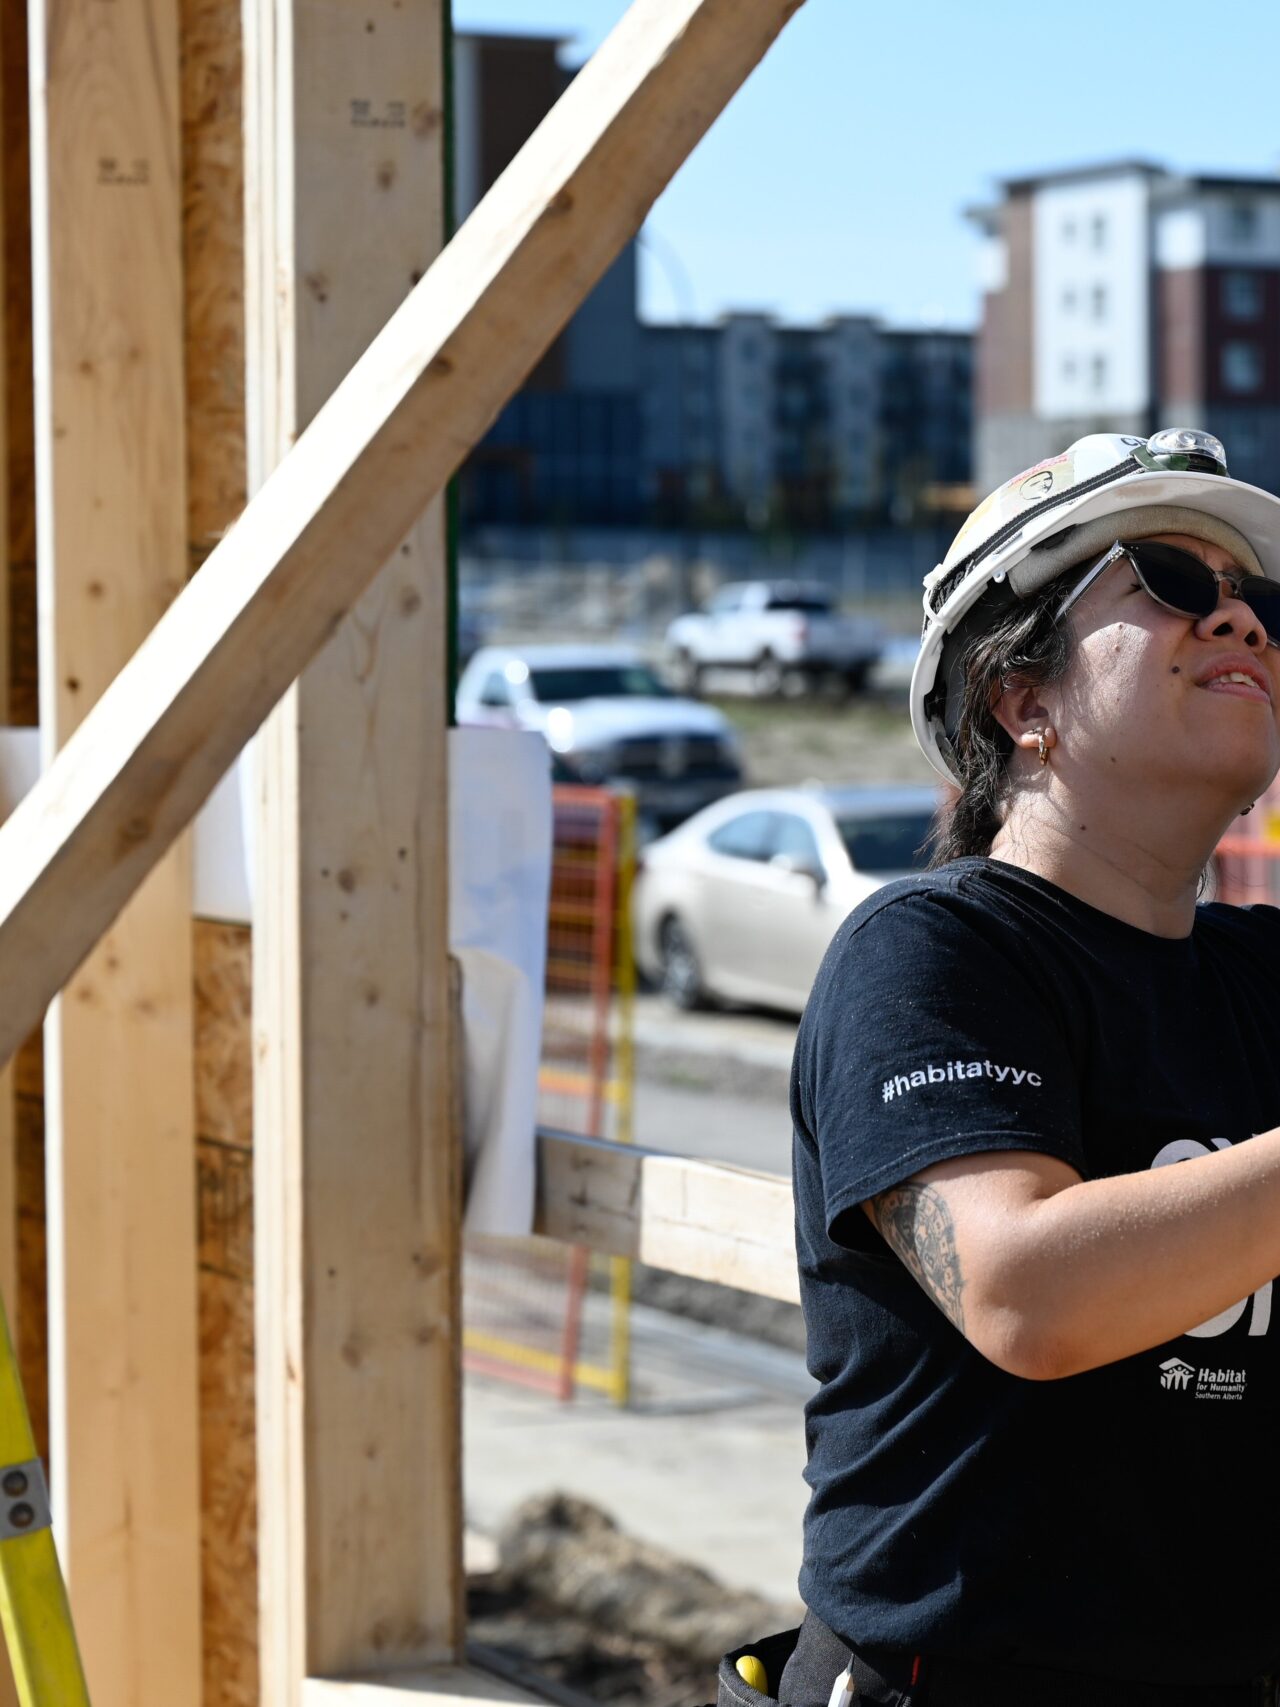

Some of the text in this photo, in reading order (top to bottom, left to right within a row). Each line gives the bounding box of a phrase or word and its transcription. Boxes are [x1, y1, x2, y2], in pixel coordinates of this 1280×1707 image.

[881, 1059, 1043, 1104] #habitatyyc
[1197, 1367, 1247, 1384] Habitat
[1196, 1382, 1246, 1394] for Humanity
[1194, 1391, 1243, 1401] Southern Alberta
